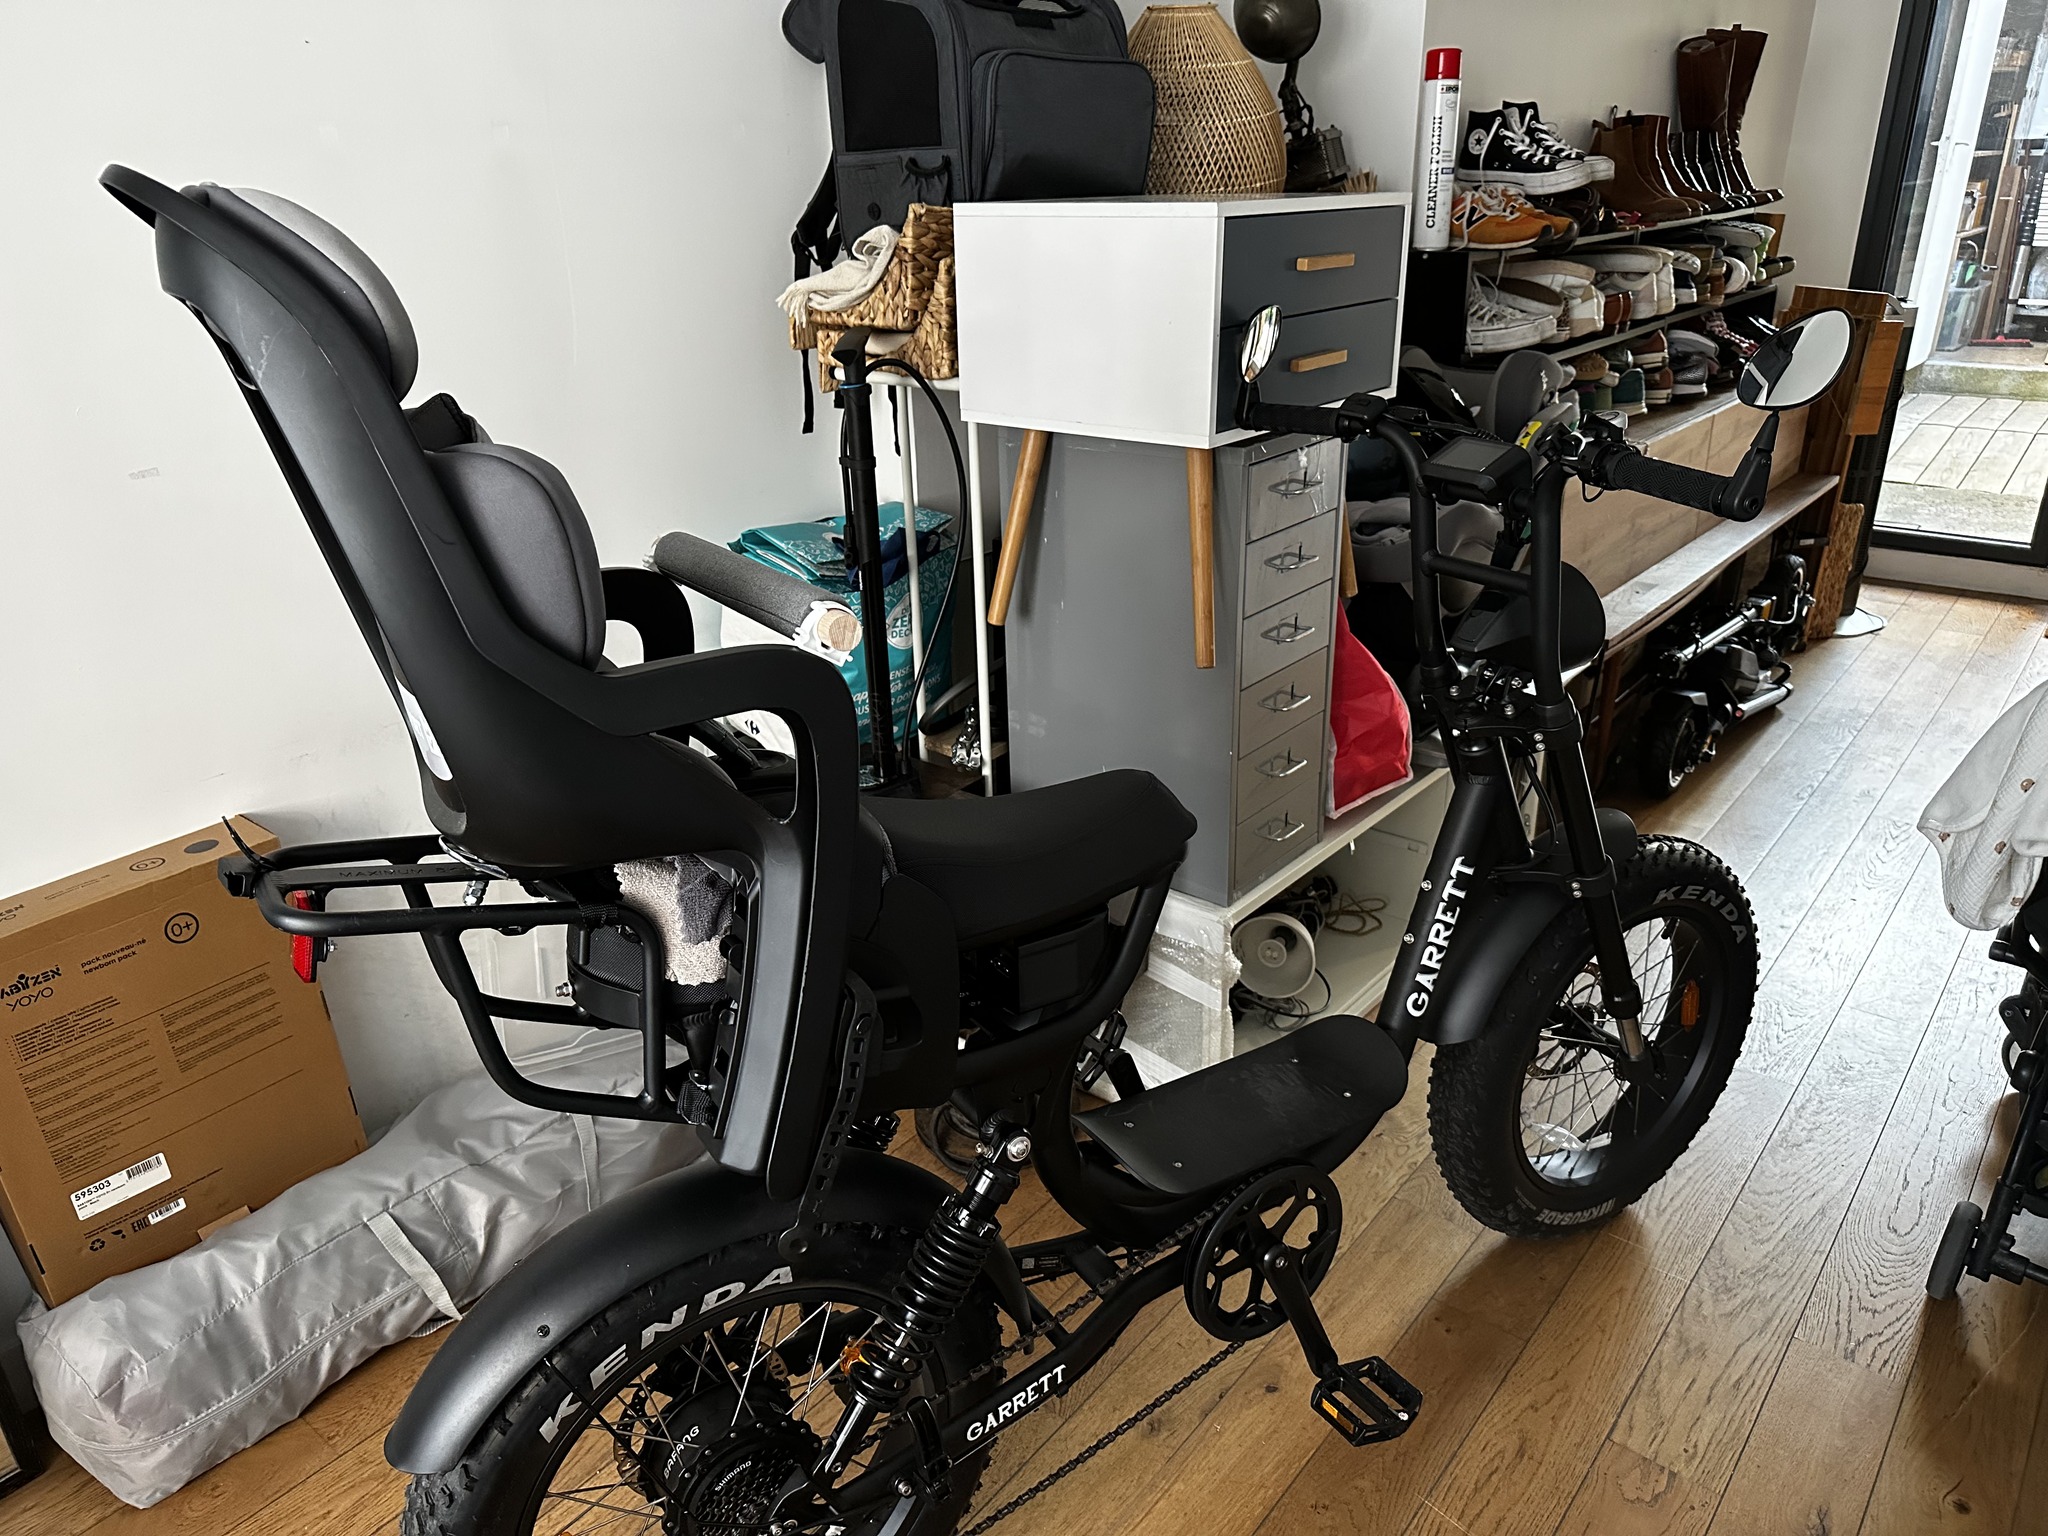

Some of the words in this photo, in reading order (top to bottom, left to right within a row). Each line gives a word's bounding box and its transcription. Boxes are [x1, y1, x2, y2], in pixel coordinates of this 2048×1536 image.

[1426, 166, 1440, 228] CLEANER
[339, 867, 424, 878] MAXIMUM
[171, 919, 194, 937] 0+
[1652, 885, 1747, 944] KENDA
[1406, 855, 1475, 1018] GARRETT
[80, 955, 101, 969] pack
[102, 937, 147, 960] nouveau-né
[83, 958, 117, 975] newborn
[117, 949, 138, 963] pack
[6, 986, 54, 1012] YOYO
[74, 1179, 111, 1202] 595303
[1535, 1204, 1602, 1226] KRUSADE
[539, 1265, 793, 1444] KENDA
[966, 1363, 1067, 1441] GARRETT
[663, 1425, 700, 1480] BAFANG
[714, 1460, 752, 1491] SHIMANO
